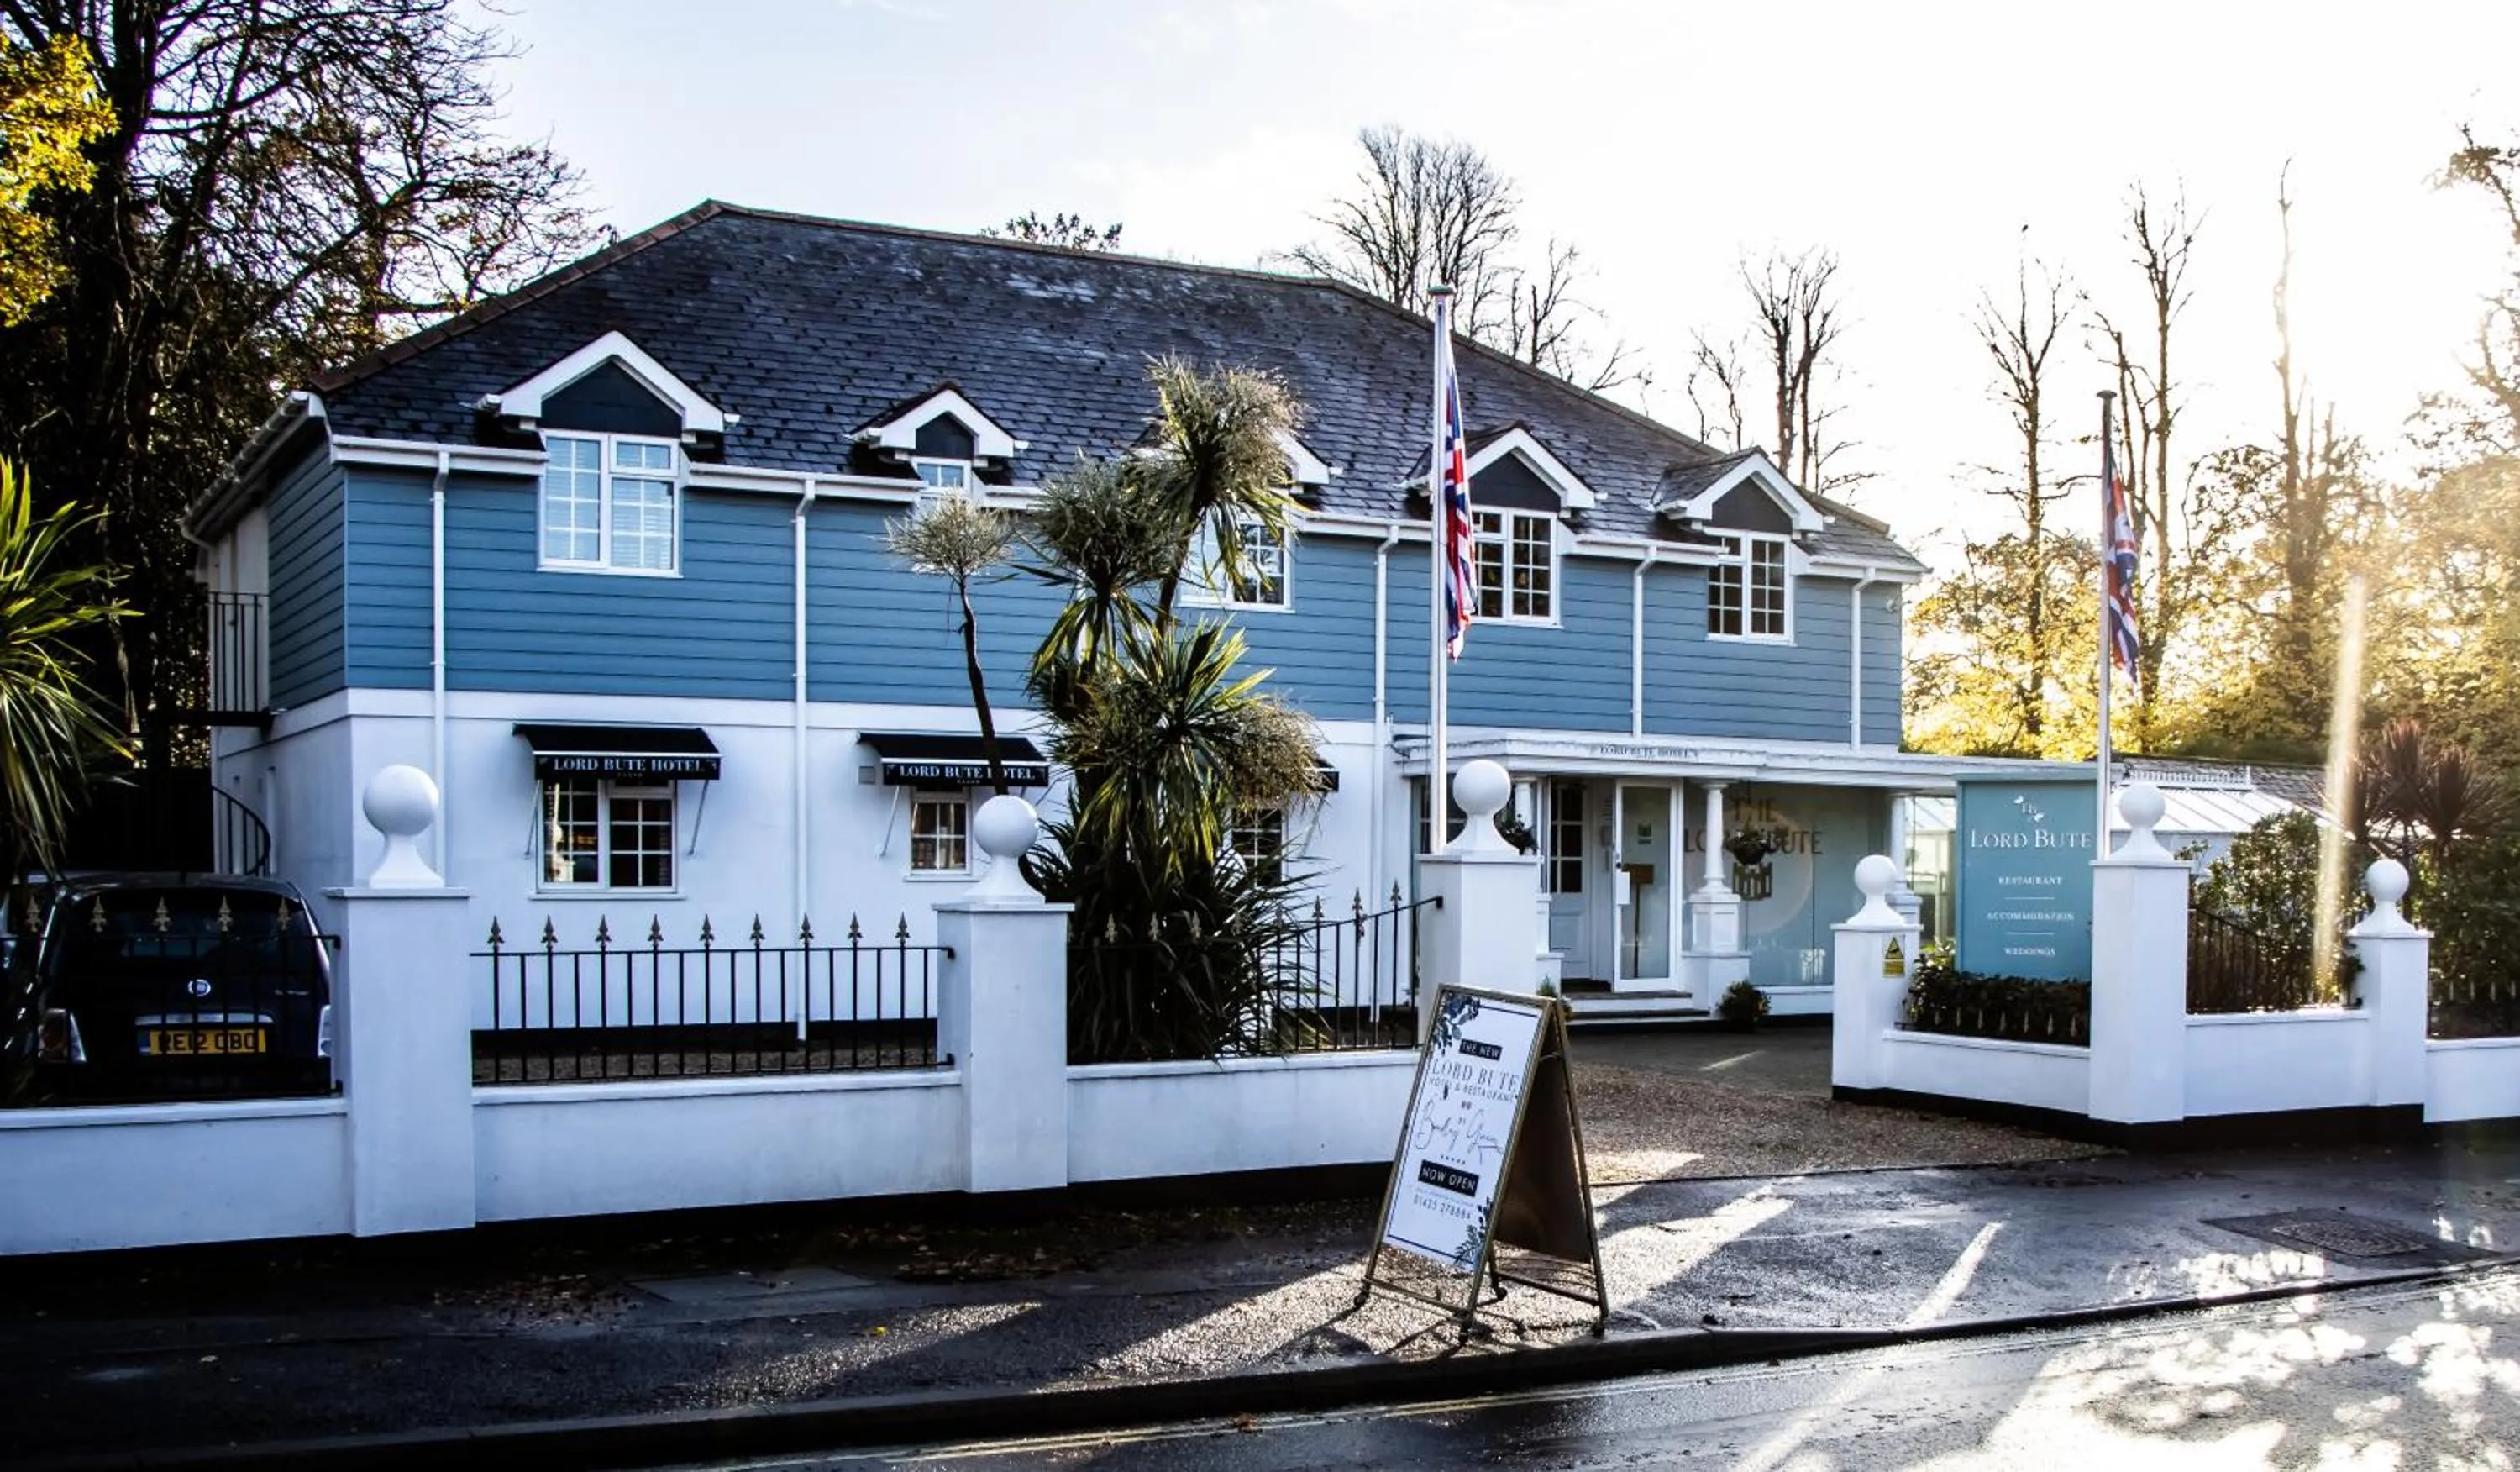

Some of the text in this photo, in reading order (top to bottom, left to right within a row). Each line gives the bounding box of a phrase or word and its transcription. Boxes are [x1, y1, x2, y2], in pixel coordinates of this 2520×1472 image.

[554, 757, 706, 773] LORD BUTE HOTEL
[900, 765, 940, 778] LORD
[945, 765, 984, 780] BUTE
[1971, 828, 2093, 849] LORD BUTE
[1998, 875, 2062, 886] RESTAURANT
[1987, 911, 2075, 921] ACCOMMODATION
[2003, 946, 2056, 956] WEDDINGS
[1462, 1041, 1500, 1059] THE NEW
[1431, 1059, 1473, 1081] LORD
[1421, 1165, 1477, 1191] NOW OPEN
